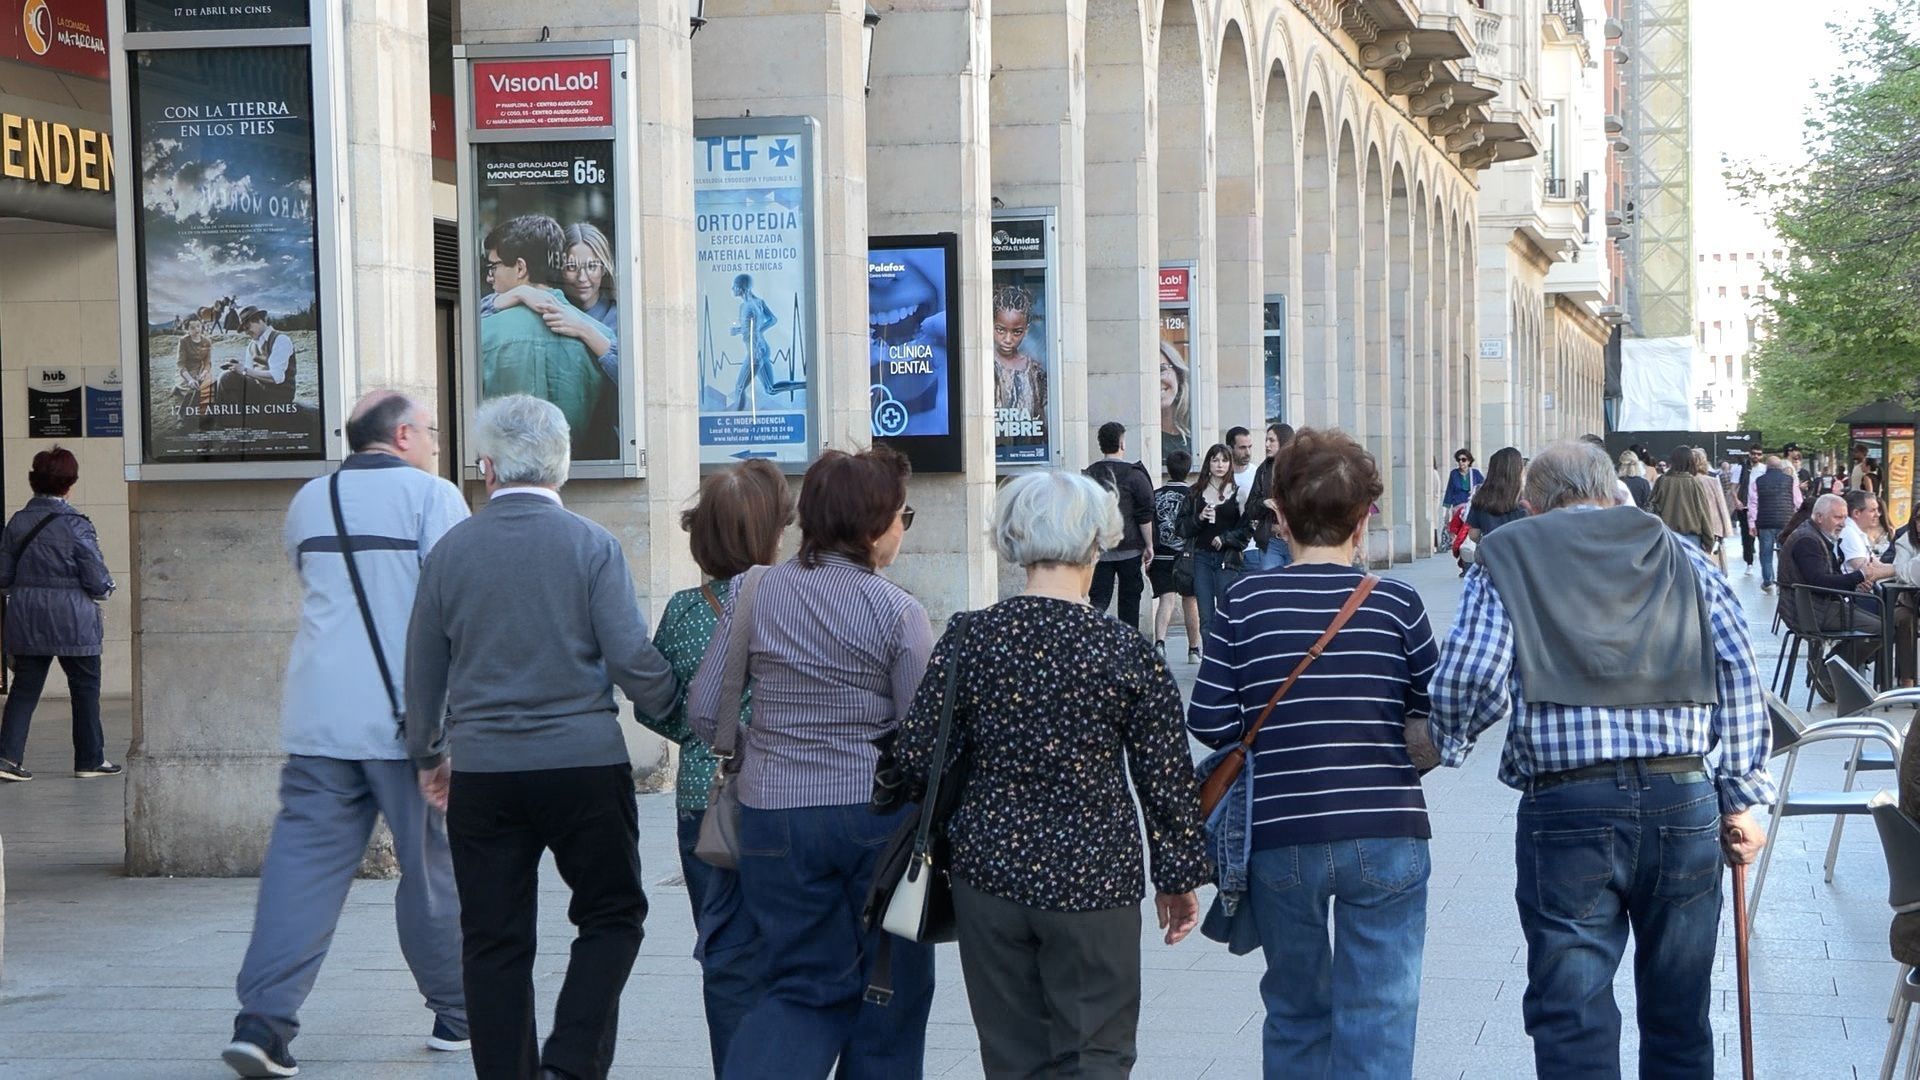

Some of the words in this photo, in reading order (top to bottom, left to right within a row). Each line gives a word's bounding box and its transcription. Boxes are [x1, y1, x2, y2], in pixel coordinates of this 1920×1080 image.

[174, 8, 182, 16] 17
[186, 8, 197, 16] DE
[200, 6, 227, 15] ABRIL
[230, 6, 242, 14] EN
[244, 5, 272, 14] CINES
[488, 71, 599, 93] VisionLab!
[164, 106, 199, 119] CON
[205, 105, 223, 118] LA
[227, 101, 290, 117] TIERRA
[180, 125, 200, 137] EN
[207, 124, 234, 136] LOS
[240, 120, 275, 135] PIES
[696, 135, 758, 172] TEF
[517, 161, 569, 169] GRADUADAS
[574, 159, 606, 184] 65€
[486, 169, 569, 179] MONOFOCALES
[697, 212, 797, 233] ORTOPEDIA
[711, 233, 783, 245] ESPECIALIZADA
[1010, 236, 1040, 245] Unidas
[698, 249, 751, 262] MATERIAL
[754, 245, 797, 260] MÉDICO
[711, 263, 743, 272] AYUDAS
[869, 262, 905, 273] Palafox
[889, 343, 933, 359] CLÍNICA
[890, 360, 934, 375] DENTAL
[42, 370, 66, 381] hub
[171, 405, 181, 416] 17
[185, 406, 201, 416] DE
[204, 403, 242, 415] ABRIL
[245, 404, 260, 414] EN
[263, 403, 298, 414] CINES
[995, 420, 1044, 437] MBRE
